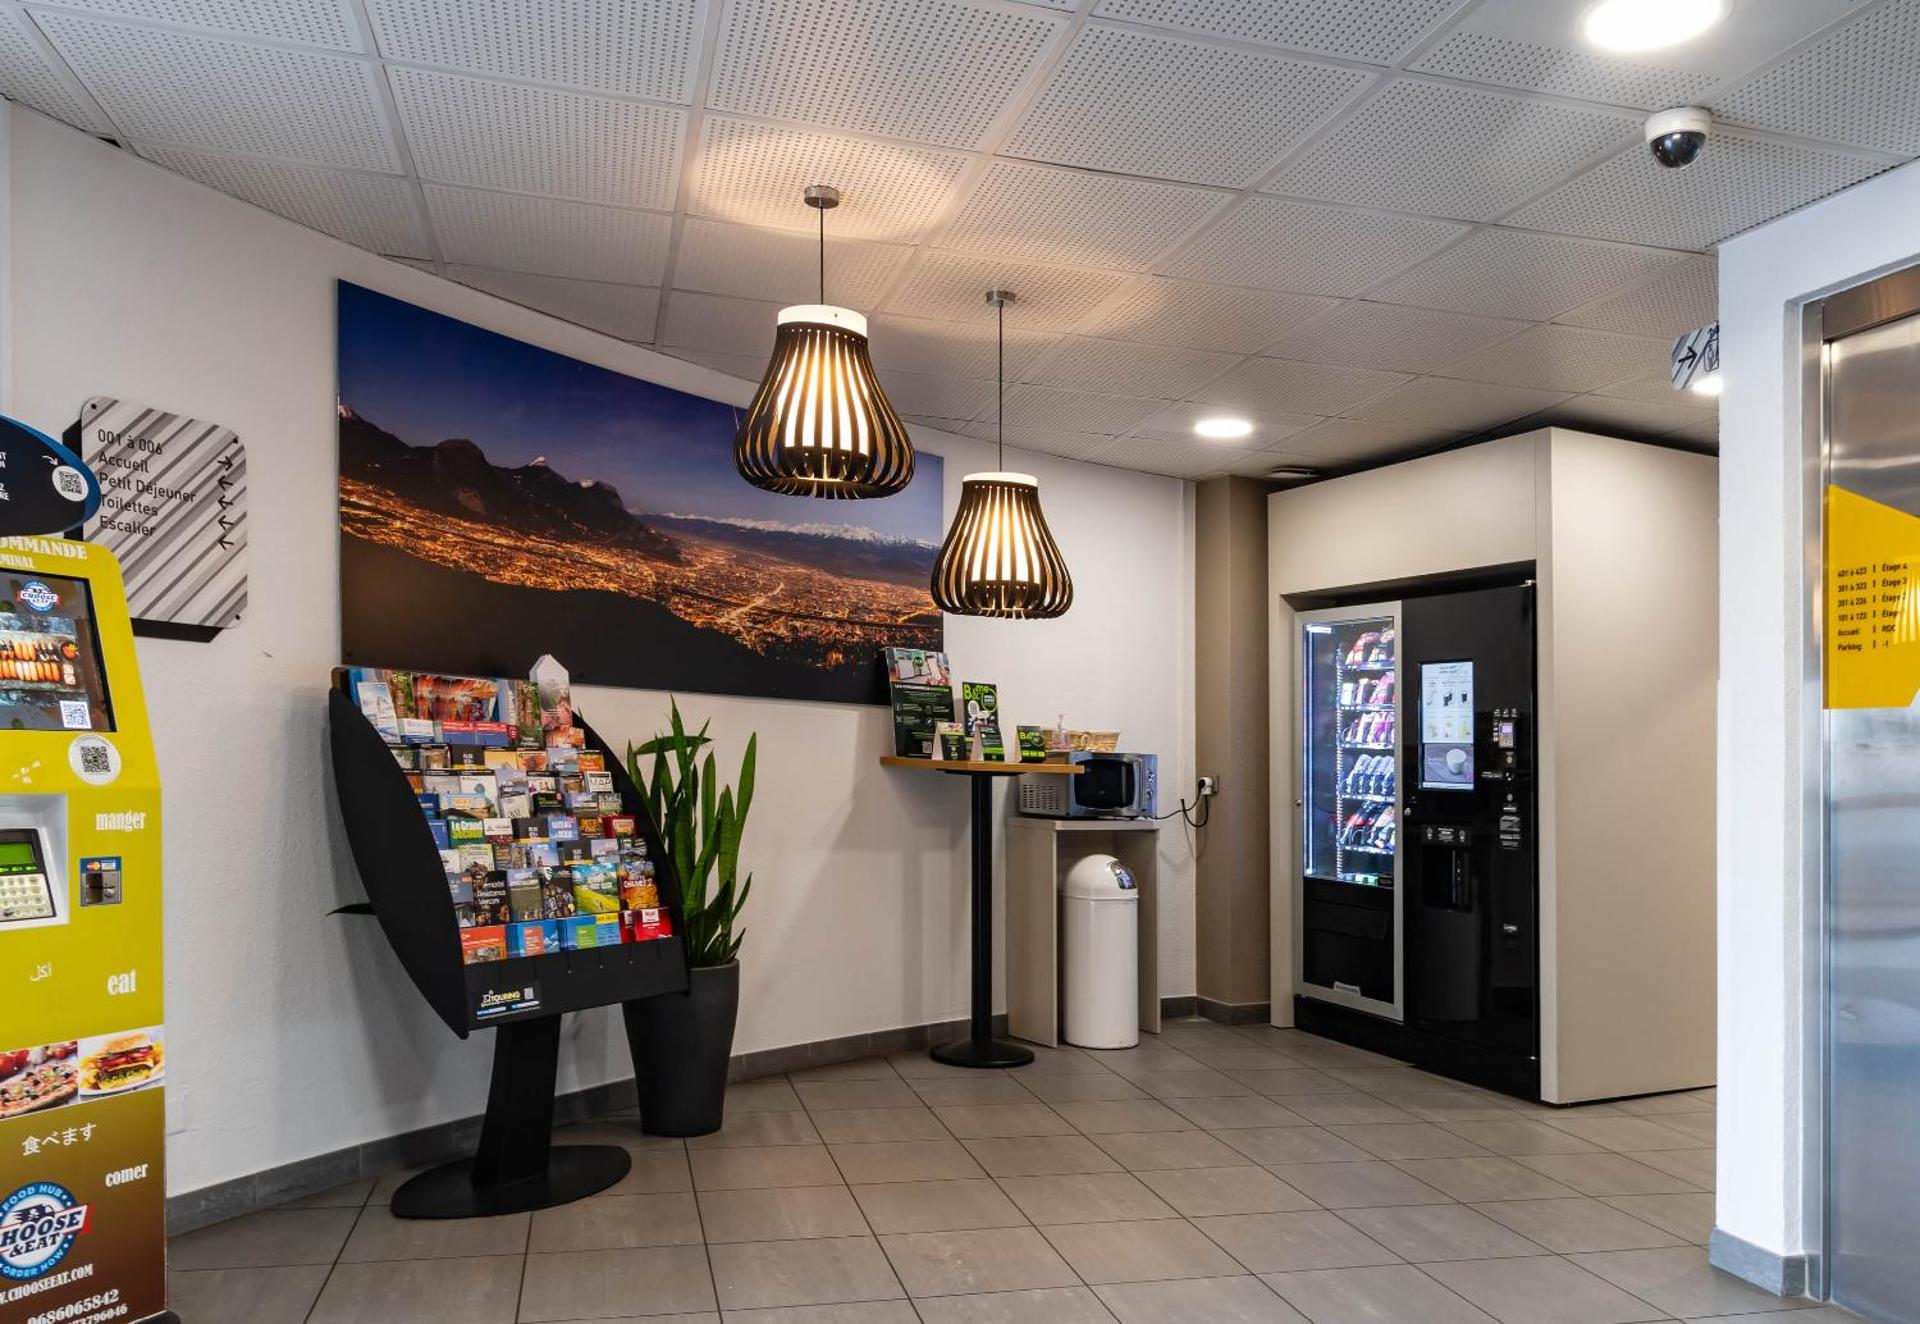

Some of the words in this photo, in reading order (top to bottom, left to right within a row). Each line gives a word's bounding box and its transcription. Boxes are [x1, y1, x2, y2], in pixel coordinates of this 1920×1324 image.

[98, 429, 122, 446] 001
[127, 435, 136, 449] à
[139, 438, 163, 455] 006
[98, 451, 149, 473] Accueil
[99, 472, 132, 491] Petit
[136, 479, 196, 502] Déjeuner
[101, 494, 159, 516] Toilettes
[100, 516, 156, 537] Escalier
[1838, 644, 1862, 652] Parking
[96, 811, 146, 832] manger
[107, 969, 137, 995] eat
[22, 1122, 97, 1156] 食べます
[105, 1163, 149, 1187] comer
[39, 1184, 63, 1198] HUB
[9, 1231, 60, 1258] &EAT
[2, 1265, 38, 1278] ORDER
[40, 1249, 64, 1271] NOW
